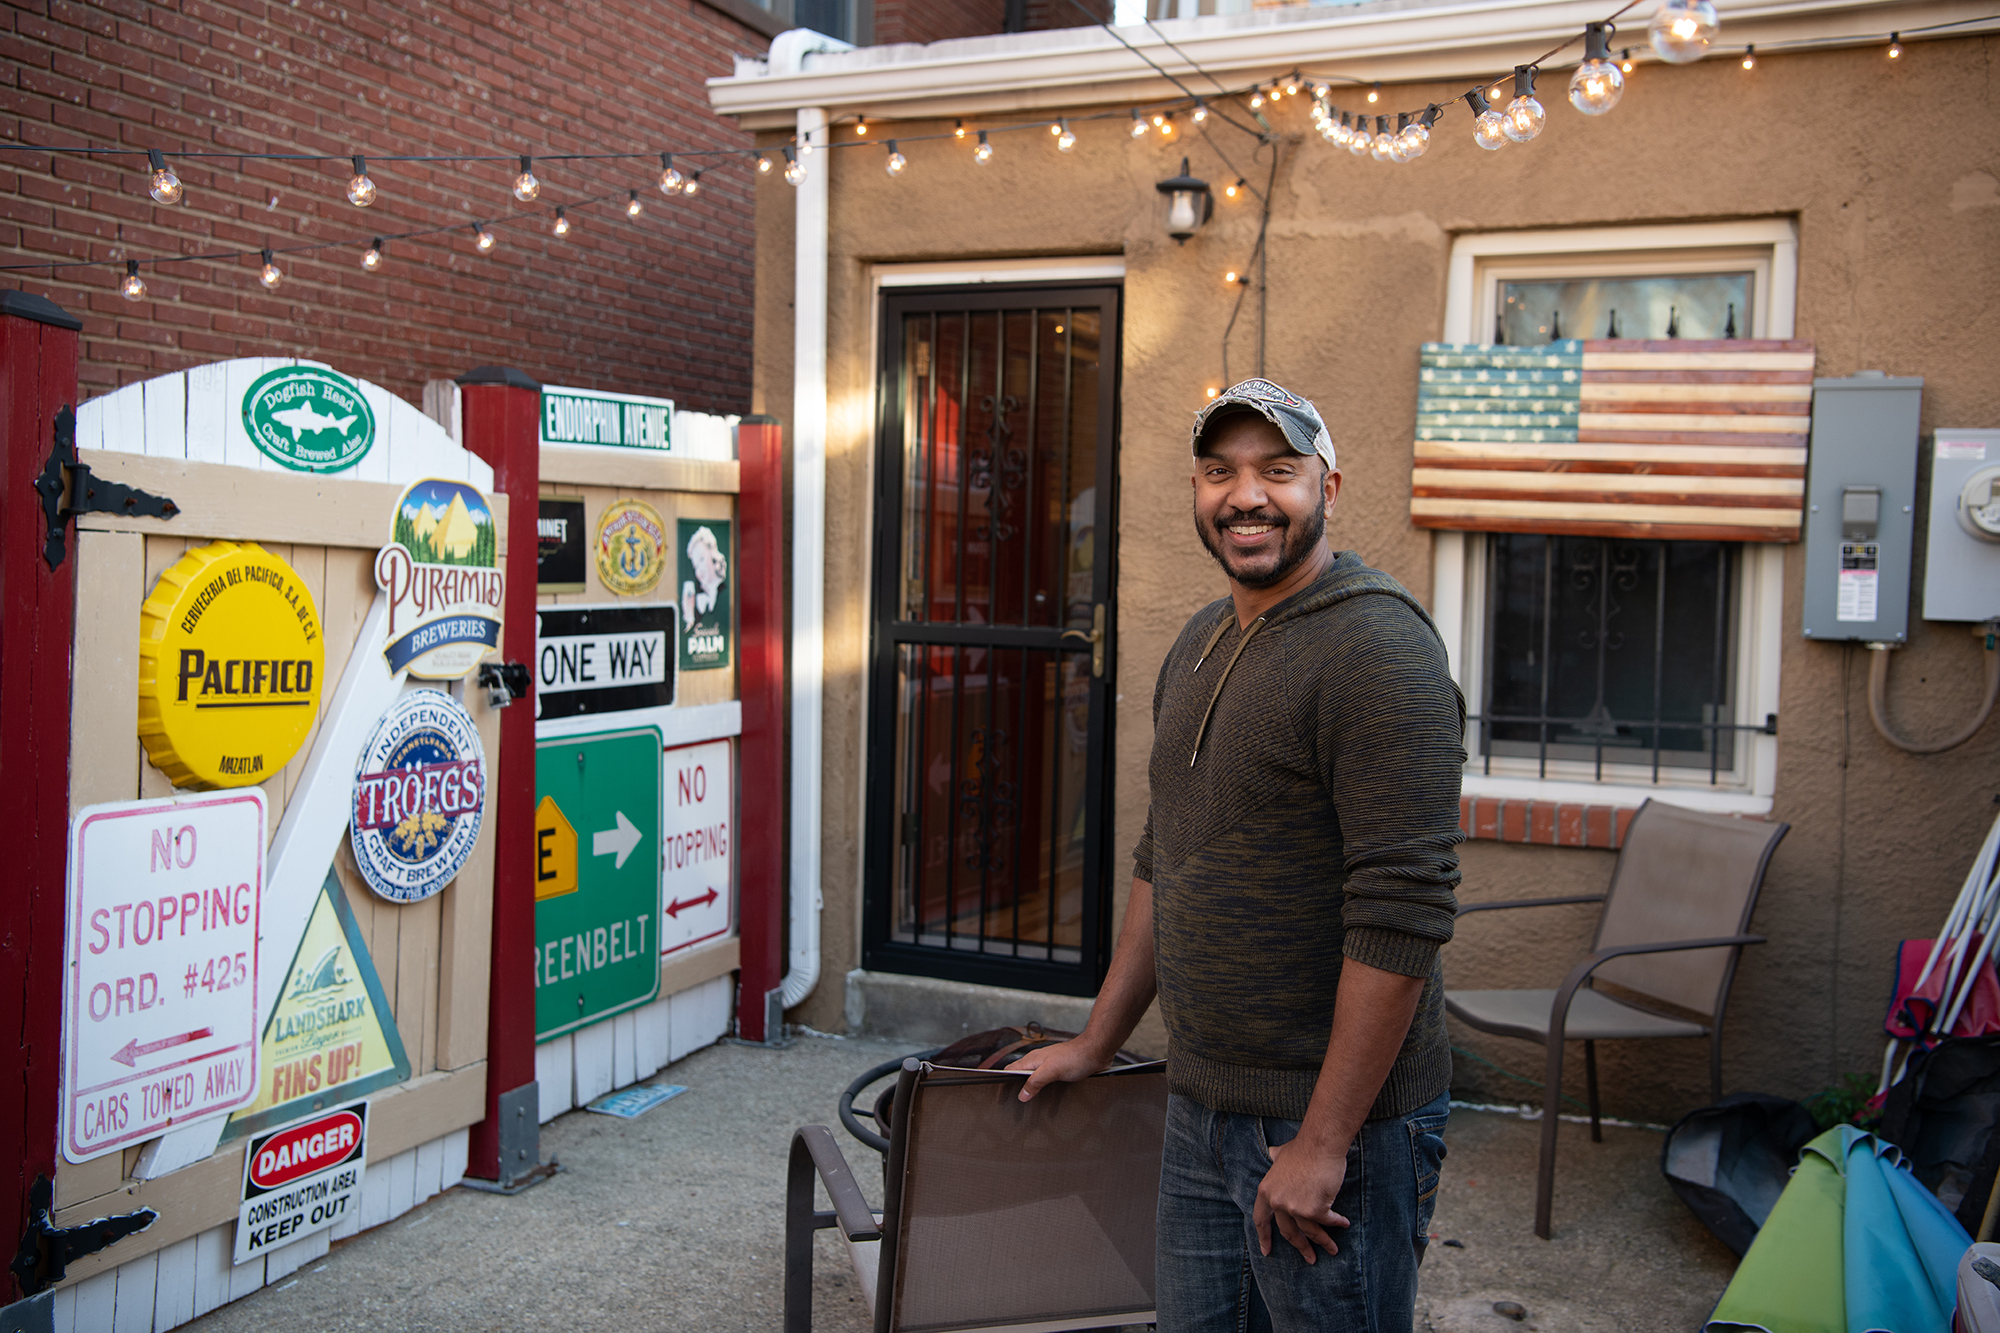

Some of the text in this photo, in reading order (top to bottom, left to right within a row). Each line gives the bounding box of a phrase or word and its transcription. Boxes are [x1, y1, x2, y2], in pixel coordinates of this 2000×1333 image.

[263, 381, 355, 413] Dogfish Head
[1252, 381, 1282, 397] RIVER
[262, 422, 362, 461] Craft Brewed Ales
[545, 395, 670, 449] ENDORPHIN AVENUE
[181, 575, 228, 635] CERVECERIA
[226, 567, 243, 587] DEL
[245, 565, 285, 596] PACIFICO,
[285, 585, 300, 611] S.A.
[296, 605, 309, 623] DE
[379, 547, 504, 637] PYRAMID
[411, 619, 487, 654] BREWERIES
[541, 638, 658, 686] ONE WAY
[688, 635, 725, 655] PALM
[176, 648, 314, 702] PACIFICO
[376, 709, 471, 762] INDEPENDENT
[391, 736, 453, 769] PENNSYLVANIA
[219, 754, 264, 775] MAZATLAN
[678, 764, 707, 807] NO
[362, 761, 478, 827] TRÖEGS
[150, 824, 198, 874] NO
[368, 819, 470, 882] CRAFT BREWERY
[662, 822, 727, 872] TOPPING
[88, 882, 251, 955] STOPPING
[88, 951, 247, 1023] ORD. #425
[275, 995, 366, 1043] LANDSHARK
[301, 1030, 340, 1051] Lager
[83, 1056, 245, 1141] CARS TOWED AWAY
[272, 1041, 362, 1105] FINS UP!
[258, 1123, 355, 1178] DANGER
[247, 1168, 357, 1227] CONSTRUCTION AREA
[249, 1194, 351, 1251] KEEP OUT
